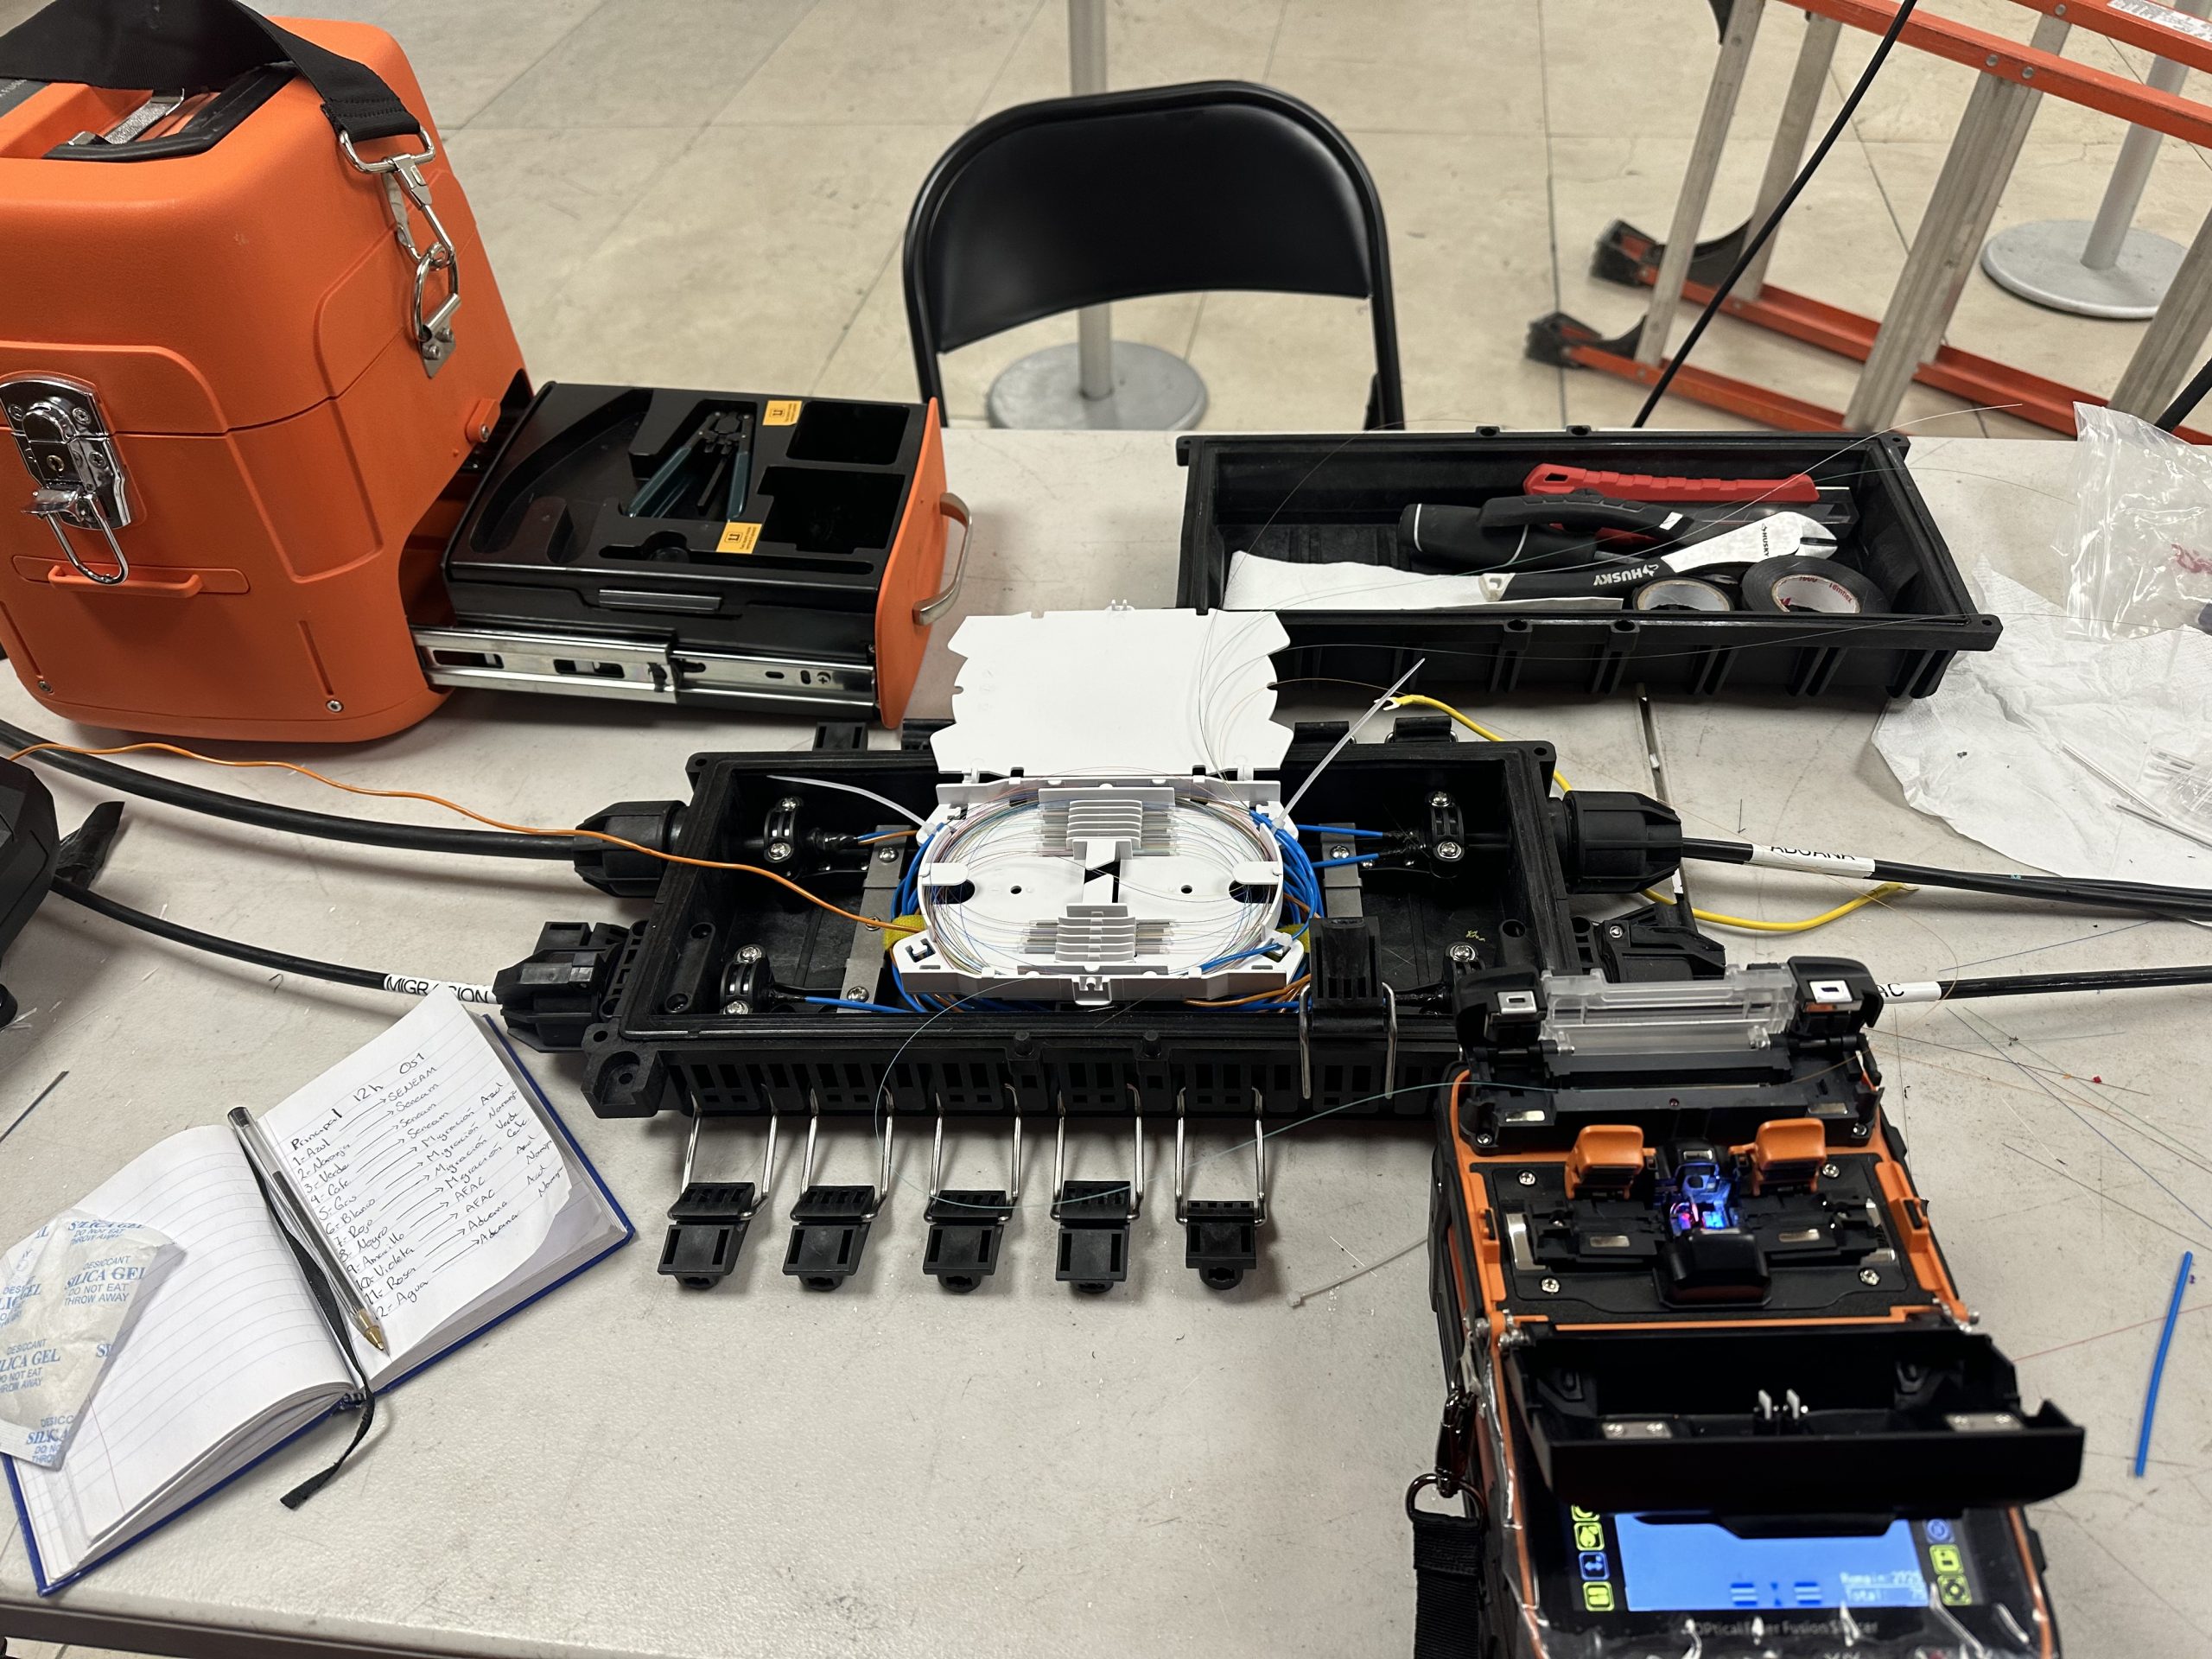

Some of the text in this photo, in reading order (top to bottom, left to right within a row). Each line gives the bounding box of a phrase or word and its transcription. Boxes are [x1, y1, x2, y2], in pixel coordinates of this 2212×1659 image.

[1593, 568, 1643, 586] HUSKY
[386, 976, 488, 1003] MIGRION
[307, 1138, 330, 1157] Azul
[388, 1066, 437, 1102] SENEAM
[290, 1108, 342, 1150] Principal
[319, 1163, 349, 1183] Verde
[455, 1177, 486, 1202] AFAC
[340, 1199, 375, 1224] Blanco
[348, 1220, 372, 1238] Rojo
[373, 1248, 415, 1277] Violeta
[467, 1189, 495, 1212] AFAC
[83, 1255, 131, 1270] DESICCANT
[387, 1268, 416, 1290] Rosa
[68, 1283, 129, 1295] DO NOT EAT
[397, 1281, 429, 1306] Agua
[64, 1293, 130, 1306] THROW AWAY
[7, 1338, 47, 1356] DESICCANT
[32, 1349, 60, 1365] GEL
[10, 1370, 26, 1382] NOT
[28, 1367, 43, 1377] EAT
[21, 1376, 43, 1389] AWAY
